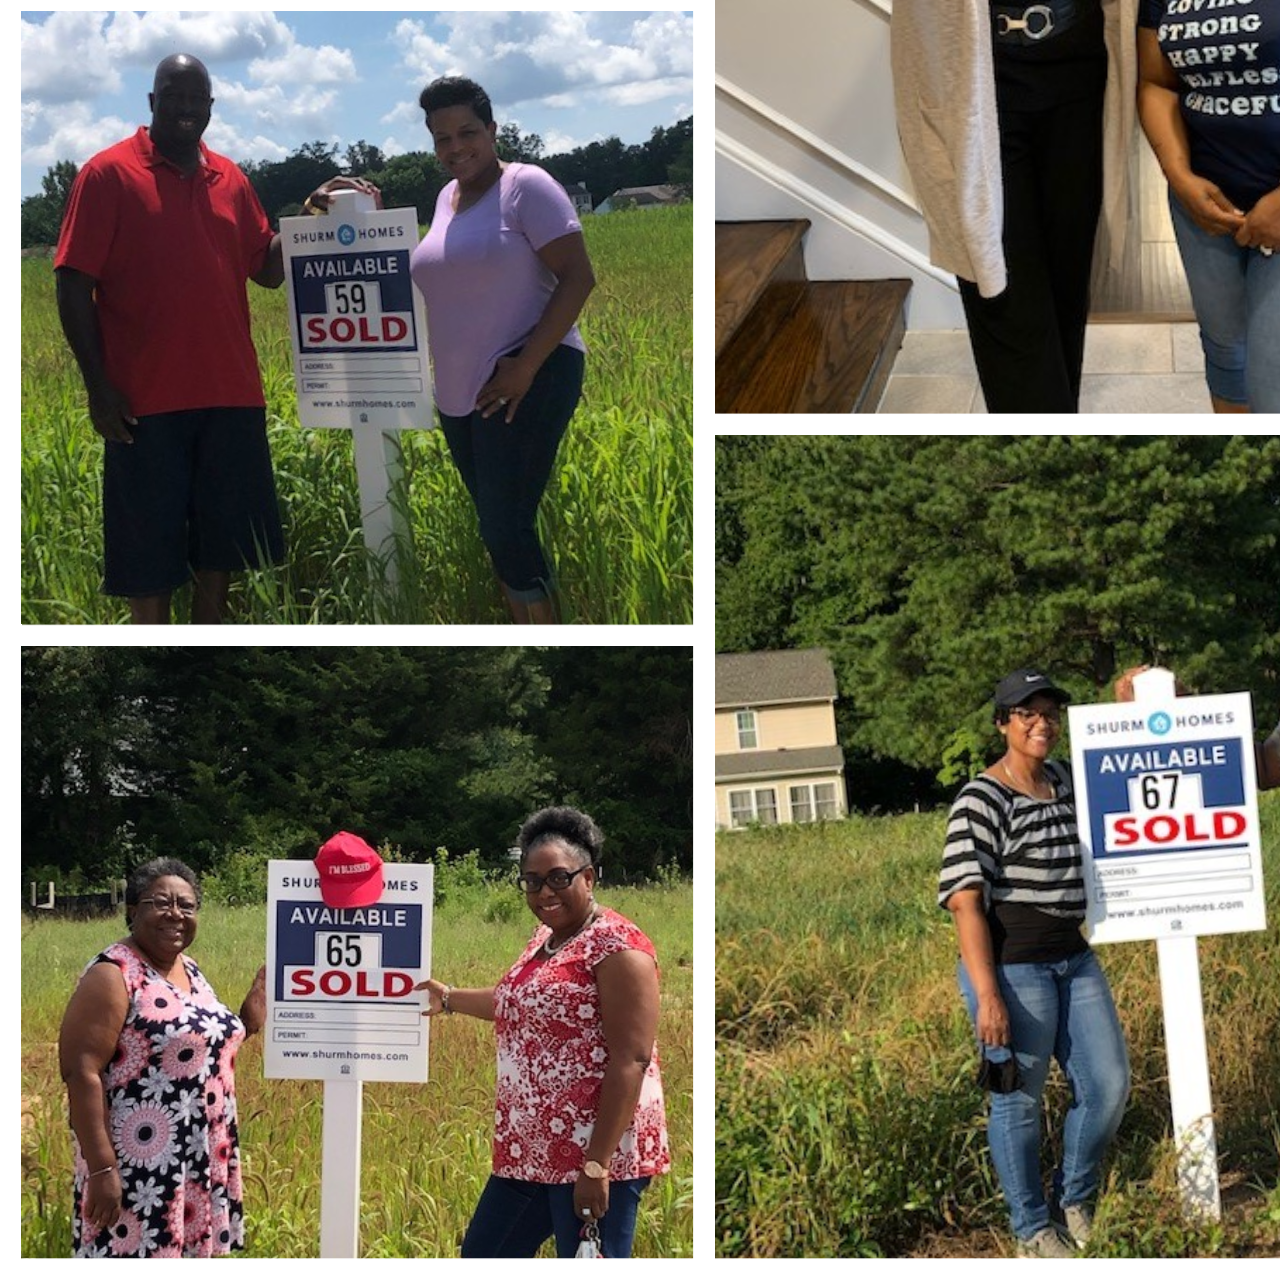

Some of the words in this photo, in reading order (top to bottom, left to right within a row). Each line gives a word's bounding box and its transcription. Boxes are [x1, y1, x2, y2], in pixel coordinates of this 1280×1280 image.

[293, 231, 335, 244] SHURM
[359, 226, 404, 239] HOMES
[303, 256, 399, 278] AVAILABLE
[334, 283, 366, 314] 59
[307, 316, 408, 343] SOLD
[313, 399, 416, 409] www.shurmhomes.com
[1087, 720, 1144, 736] SHURM
[1176, 711, 1235, 727] HOMES
[1100, 745, 1226, 773] AVAILABLE
[1141, 774, 1180, 810] 67
[1113, 811, 1247, 846] SOLD
[329, 864, 340, 874] I'M
[341, 862, 370, 874] BLESSED
[282, 877, 320, 888] SHUR
[382, 880, 418, 891] MES
[290, 907, 406, 927] AVAILABLE
[1107, 900, 1244, 919] www.shurmhomes.com
[326, 934, 362, 967] 65
[291, 970, 414, 998] SOLD
[282, 1050, 409, 1061] www.shurmhomes.com
